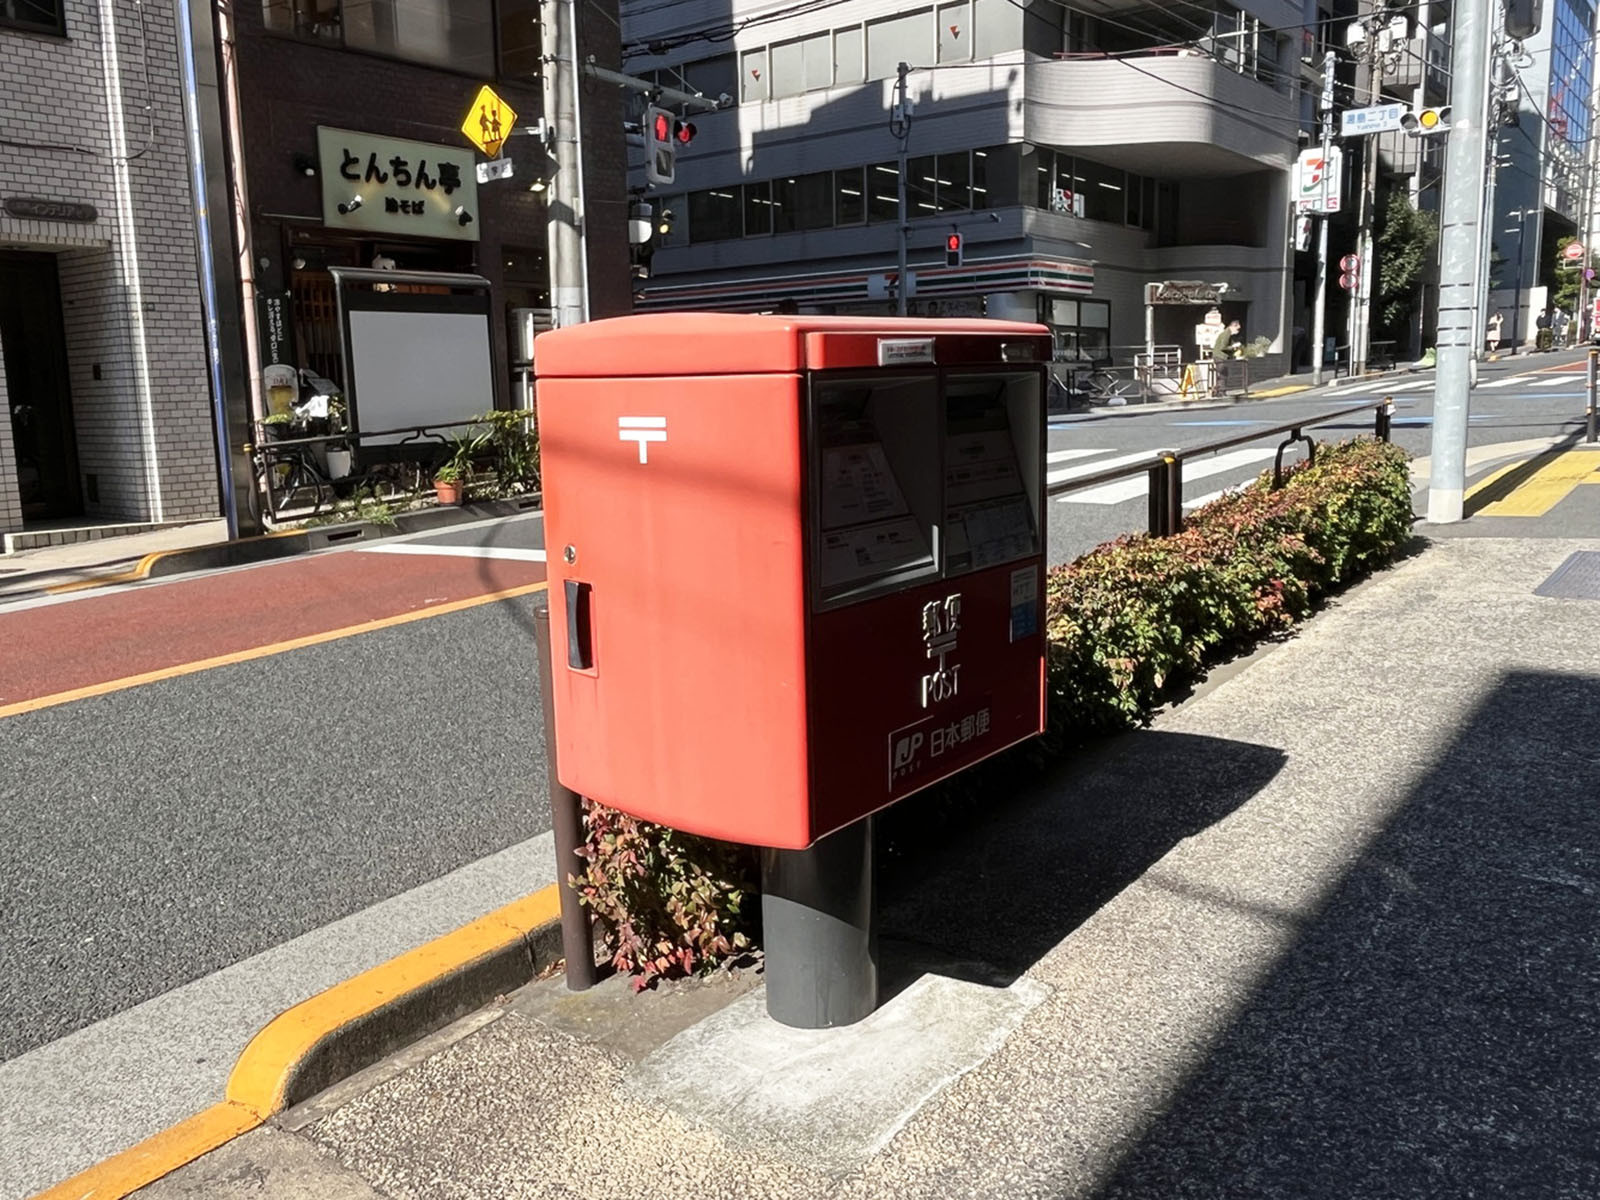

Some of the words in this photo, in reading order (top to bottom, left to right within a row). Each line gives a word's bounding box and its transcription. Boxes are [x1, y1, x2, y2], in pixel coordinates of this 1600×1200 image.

[340, 148, 462, 195] とんちん亭
[922, 592, 963, 642] 郵便
[921, 663, 962, 709] POST
[930, 707, 990, 758] 日本郵便
